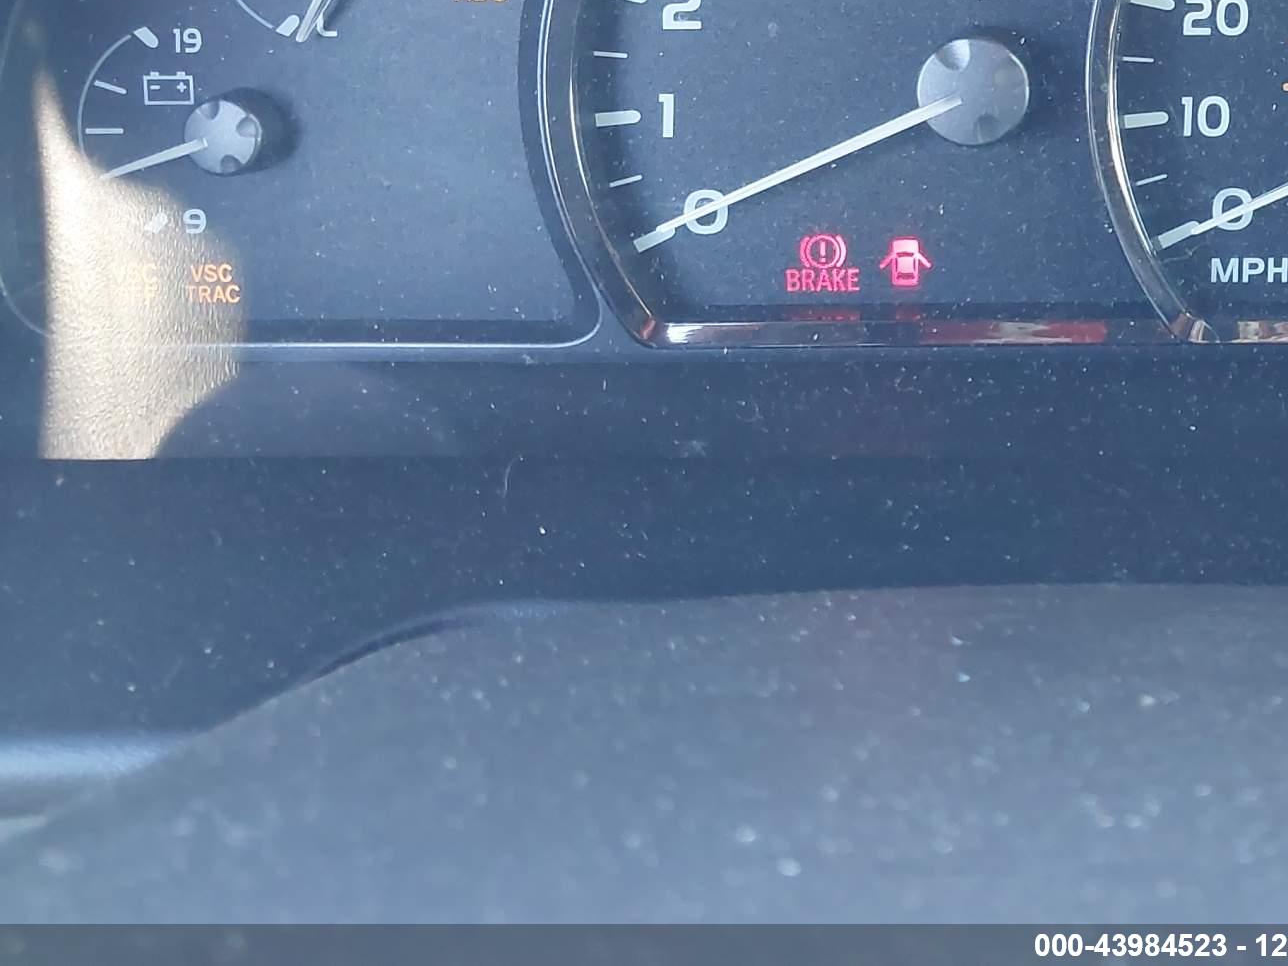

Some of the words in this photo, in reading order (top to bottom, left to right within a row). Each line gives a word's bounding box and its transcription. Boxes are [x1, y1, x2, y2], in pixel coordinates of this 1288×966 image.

[173, 28, 202, 53] 19
[658, 94, 675, 138] 1
[1180, 96, 1230, 137] 10
[182, 208, 207, 234] 9
[683, 190, 729, 235] 0
[1211, 187, 1255, 231] 0
[190, 264, 233, 282] VSC
[785, 270, 860, 292] BRAKE
[1209, 257, 1288, 284] MPH
[184, 285, 241, 303] TRAC
